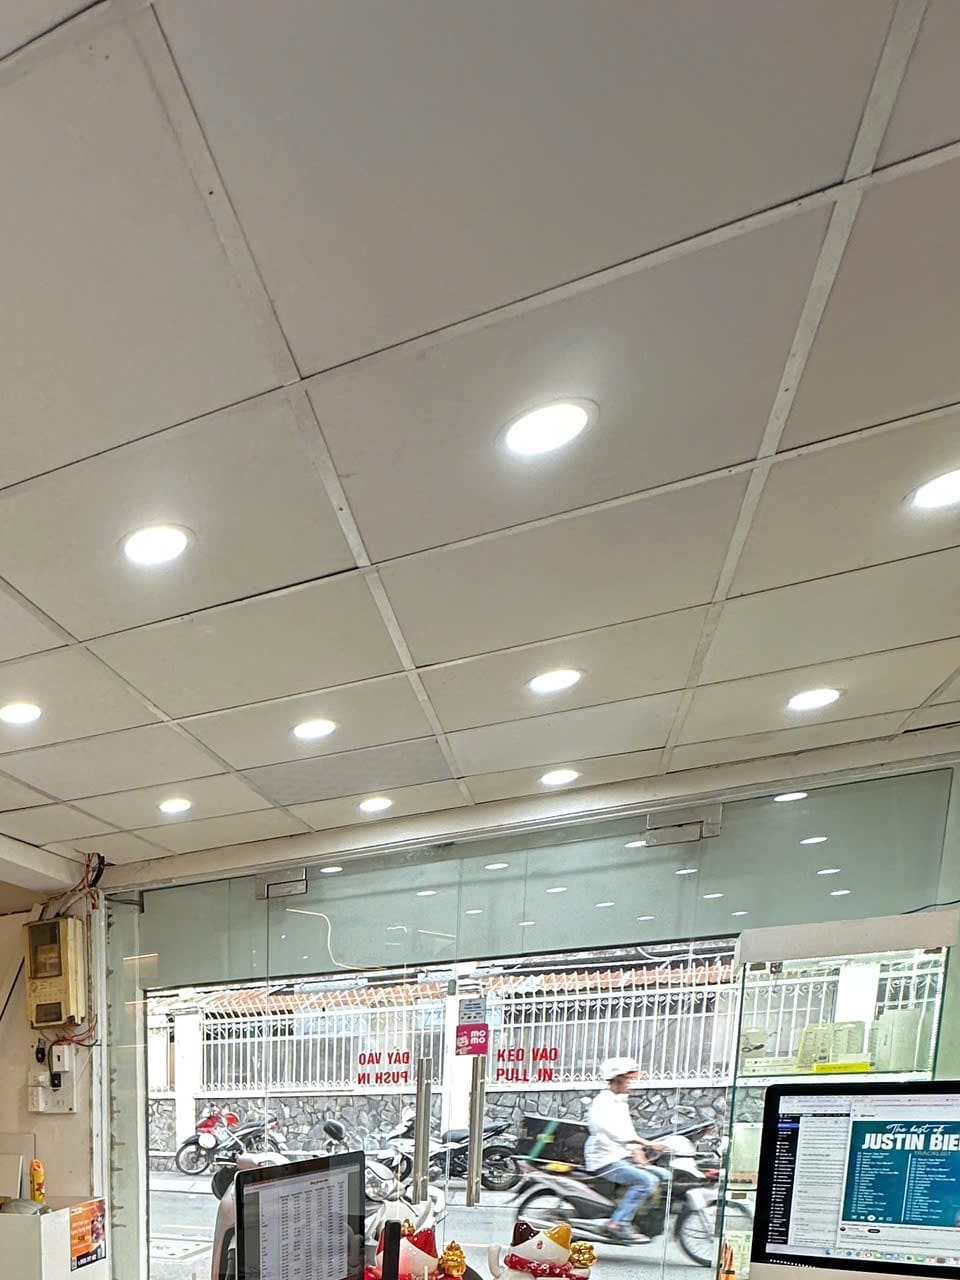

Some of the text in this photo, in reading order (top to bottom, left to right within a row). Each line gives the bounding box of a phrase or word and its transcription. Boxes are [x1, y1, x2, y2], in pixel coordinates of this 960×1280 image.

[497, 1045, 525, 1062] KÉO
[496, 1068, 553, 1082] PULL IN
[861, 1133, 960, 1151] JUSTIN BIE
